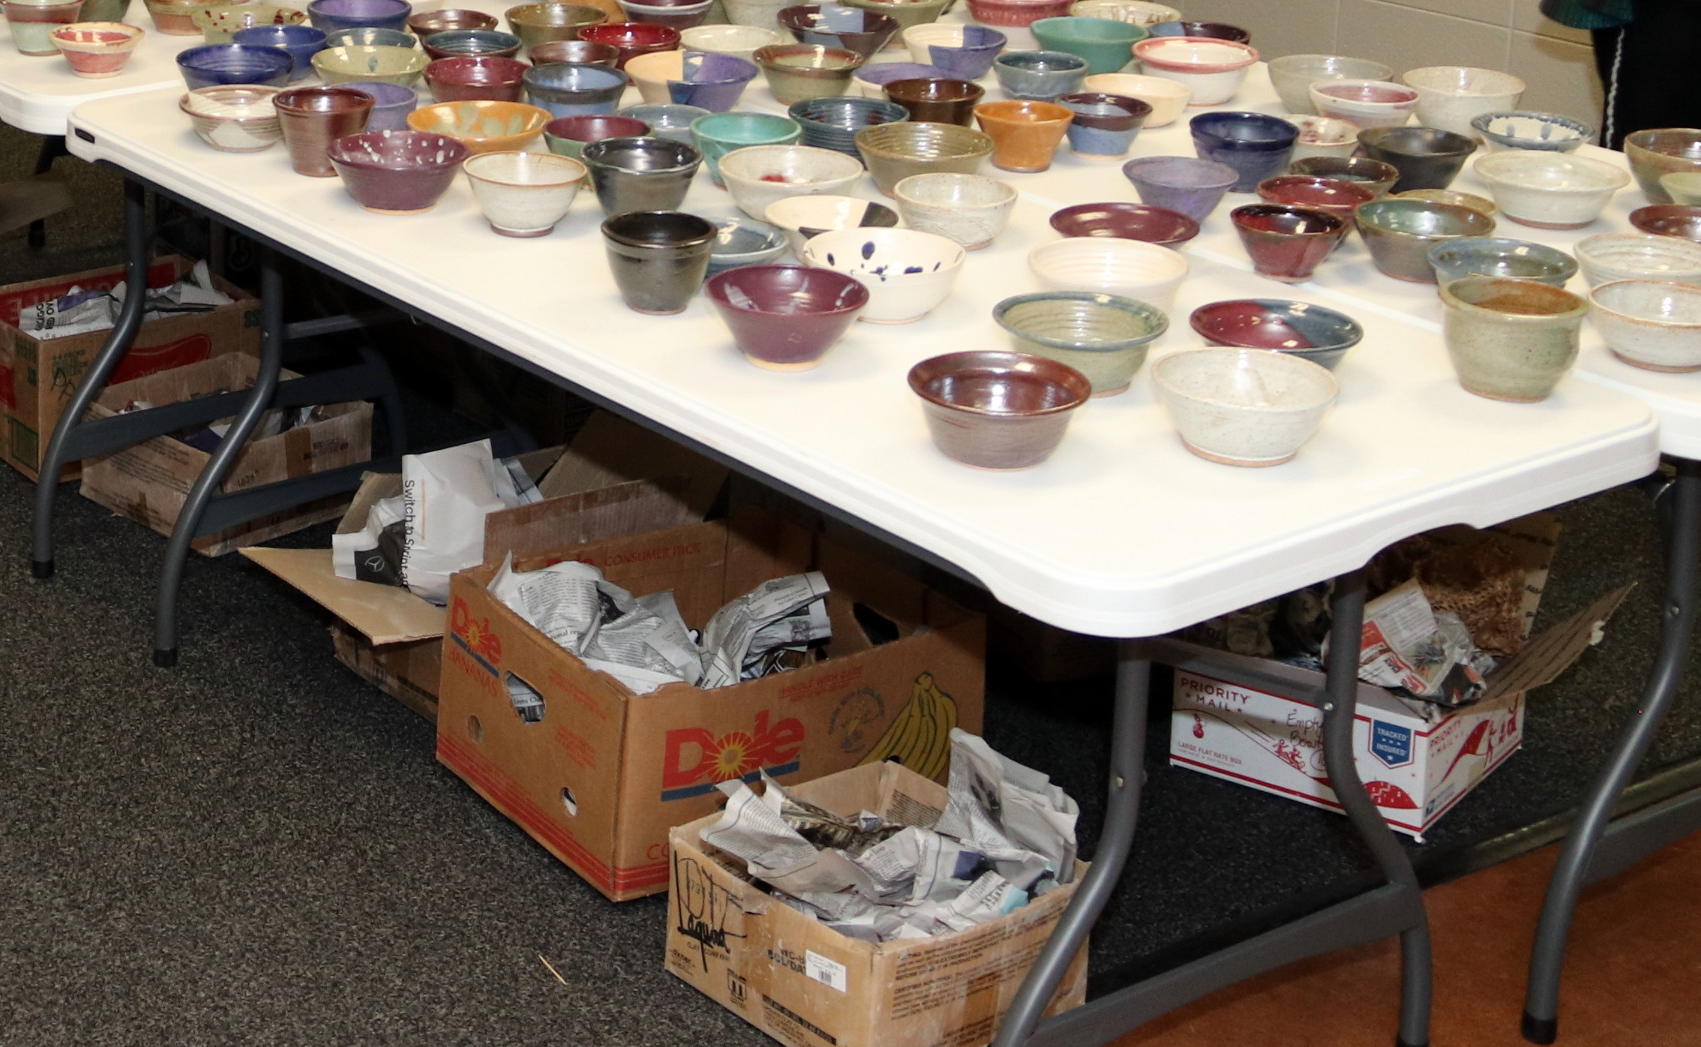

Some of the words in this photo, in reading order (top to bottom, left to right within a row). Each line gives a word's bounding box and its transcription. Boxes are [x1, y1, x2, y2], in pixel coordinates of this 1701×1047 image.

[404, 479, 416, 525] Switch
[404, 524, 415, 535] to
[604, 551, 670, 567] CONSUMER
[673, 544, 700, 557] PACK
[451, 595, 502, 665] Dole
[449, 646, 498, 697] BANANAS
[779, 679, 813, 696] HANDLE
[1180, 677, 1250, 705] PRIORITY
[1196, 695, 1231, 713] MAIL
[1376, 727, 1407, 742] TRACKED
[662, 709, 805, 790] Dole
[1178, 741, 1198, 753] LARGE
[1198, 746, 1213, 757] FLAT
[1376, 743, 1406, 757] INSURED
